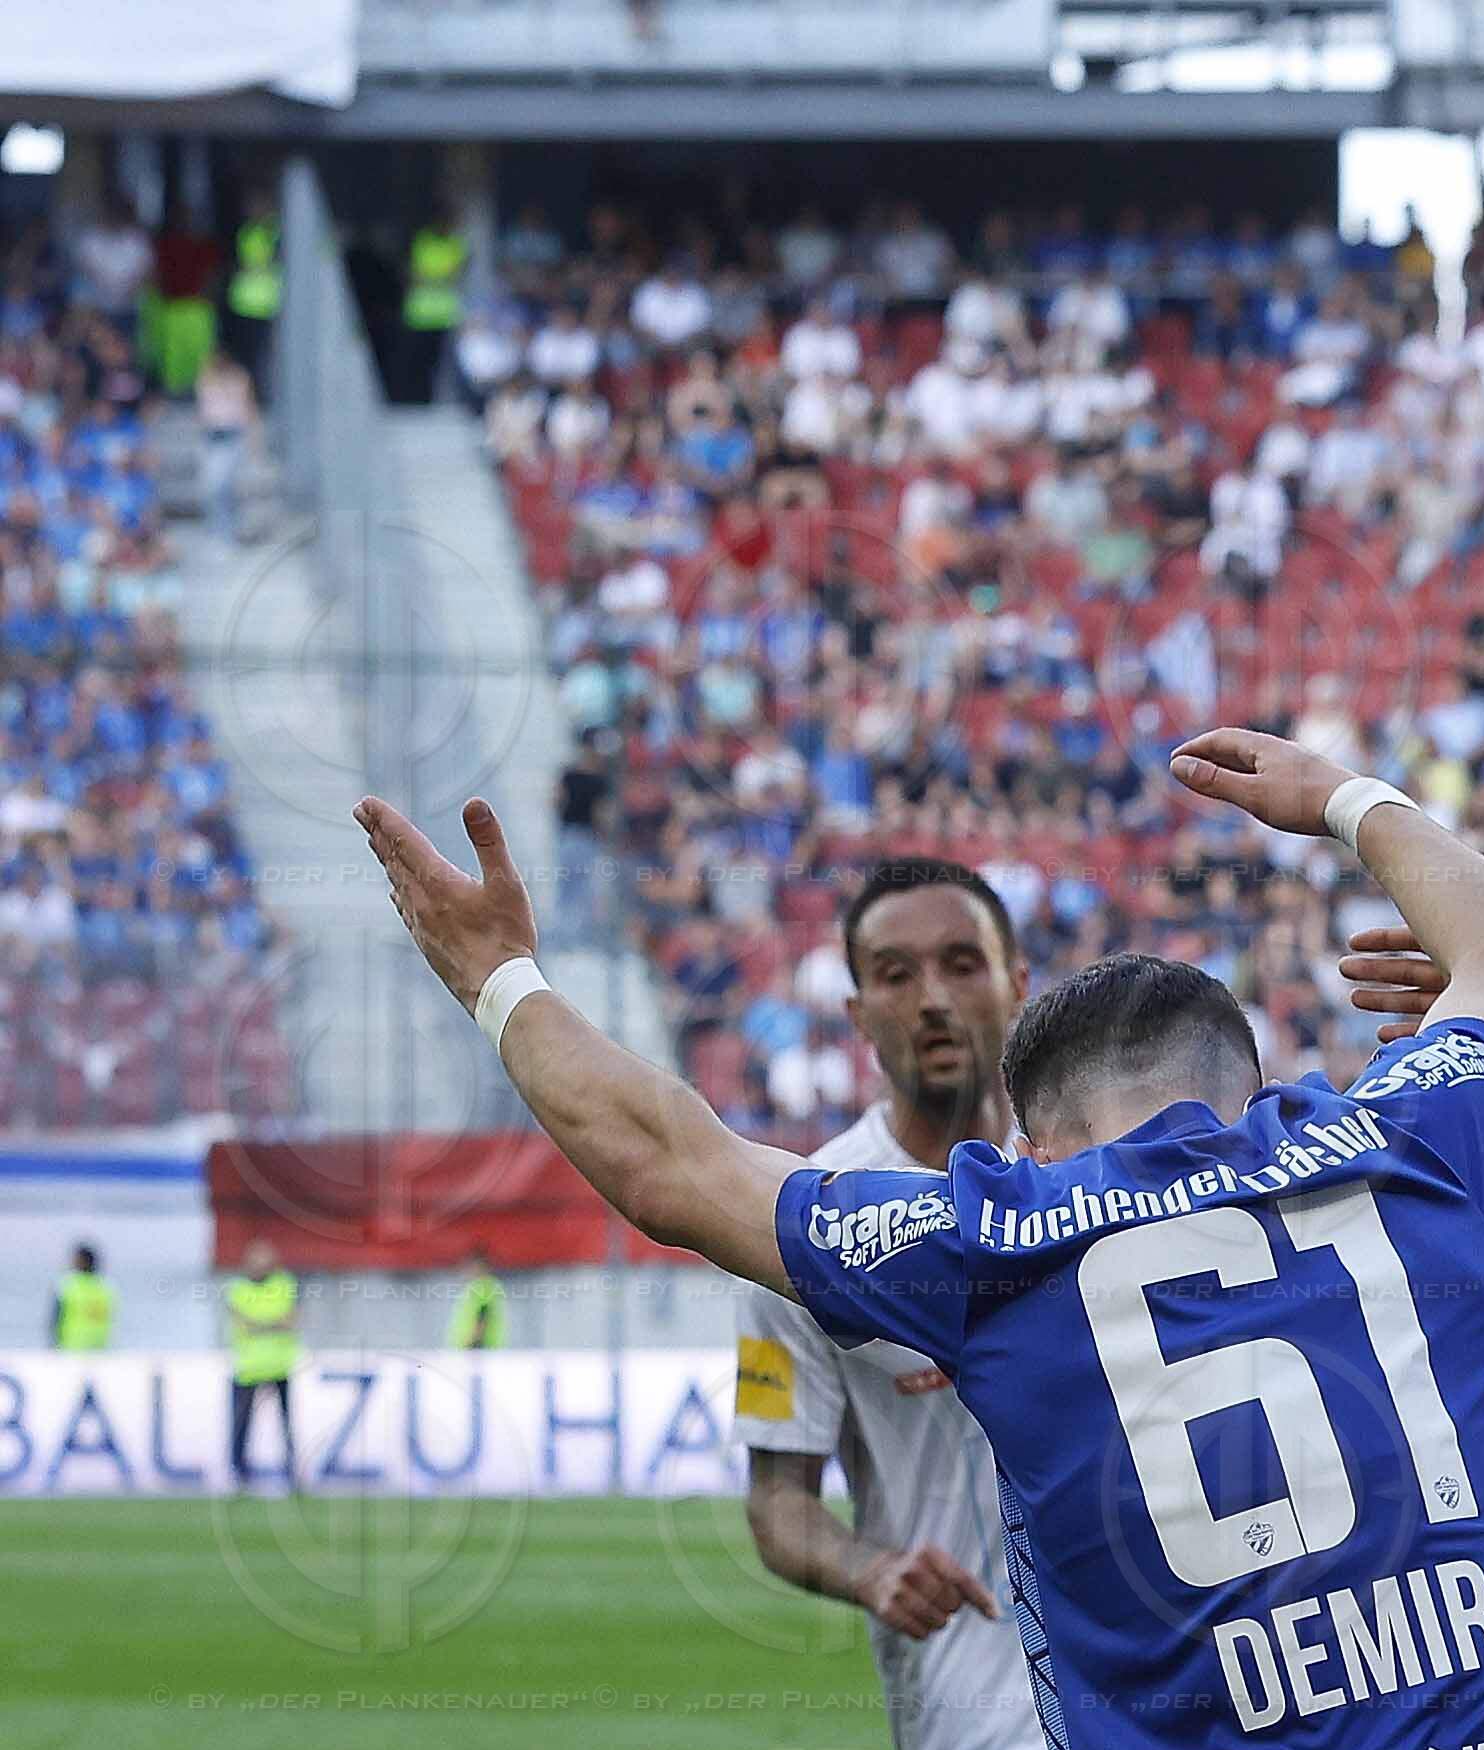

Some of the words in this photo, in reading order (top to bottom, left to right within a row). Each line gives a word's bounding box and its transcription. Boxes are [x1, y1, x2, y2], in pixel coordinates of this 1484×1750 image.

[1415, 1067, 1455, 1090] SOFT
[839, 1238, 879, 1269] SOFT
[893, 1215, 956, 1248] DRINKS
[1078, 1180, 1479, 1588] 61
